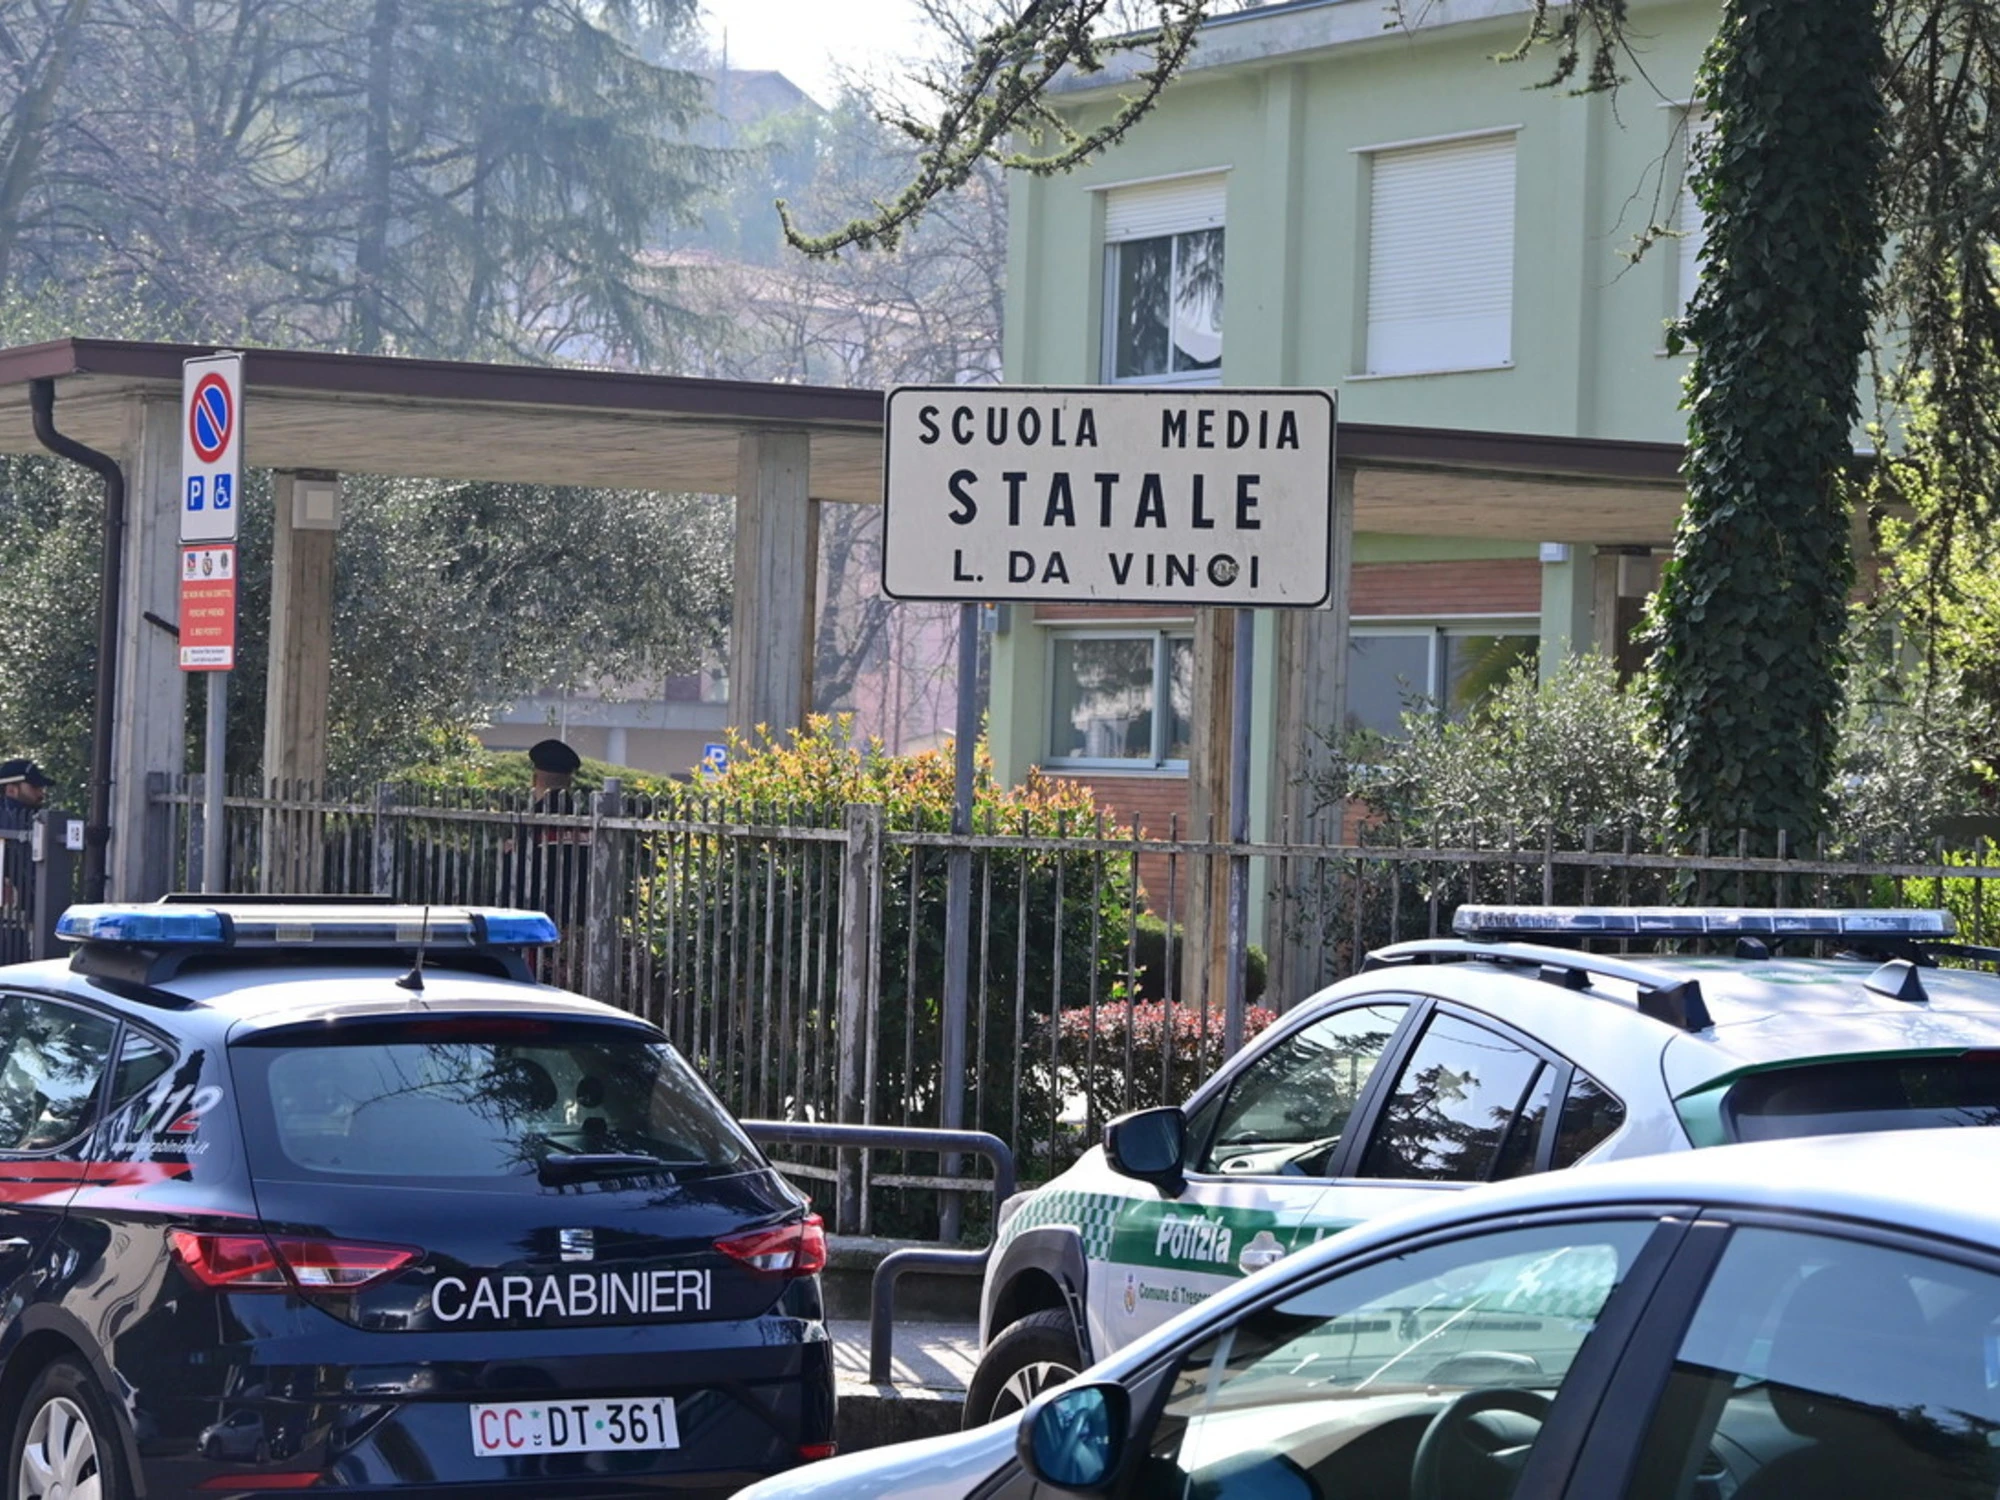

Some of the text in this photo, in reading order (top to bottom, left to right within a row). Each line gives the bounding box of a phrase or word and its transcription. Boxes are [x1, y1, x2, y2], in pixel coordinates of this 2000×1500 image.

[918, 405, 1300, 450] SCUOLA MEDIA
[190, 480, 202, 507] P
[947, 469, 1262, 530] STATALE
[953, 549, 1260, 589] L. DA VINCI
[710, 748, 726, 770] P
[133, 1084, 224, 1134] 112
[1155, 1213, 1233, 1264] Polizia
[431, 1268, 711, 1322] CARABINIERI
[1138, 1282, 1170, 1302] Comune
[1172, 1286, 1180, 1303] di
[479, 1403, 666, 1450] CC DT 361
